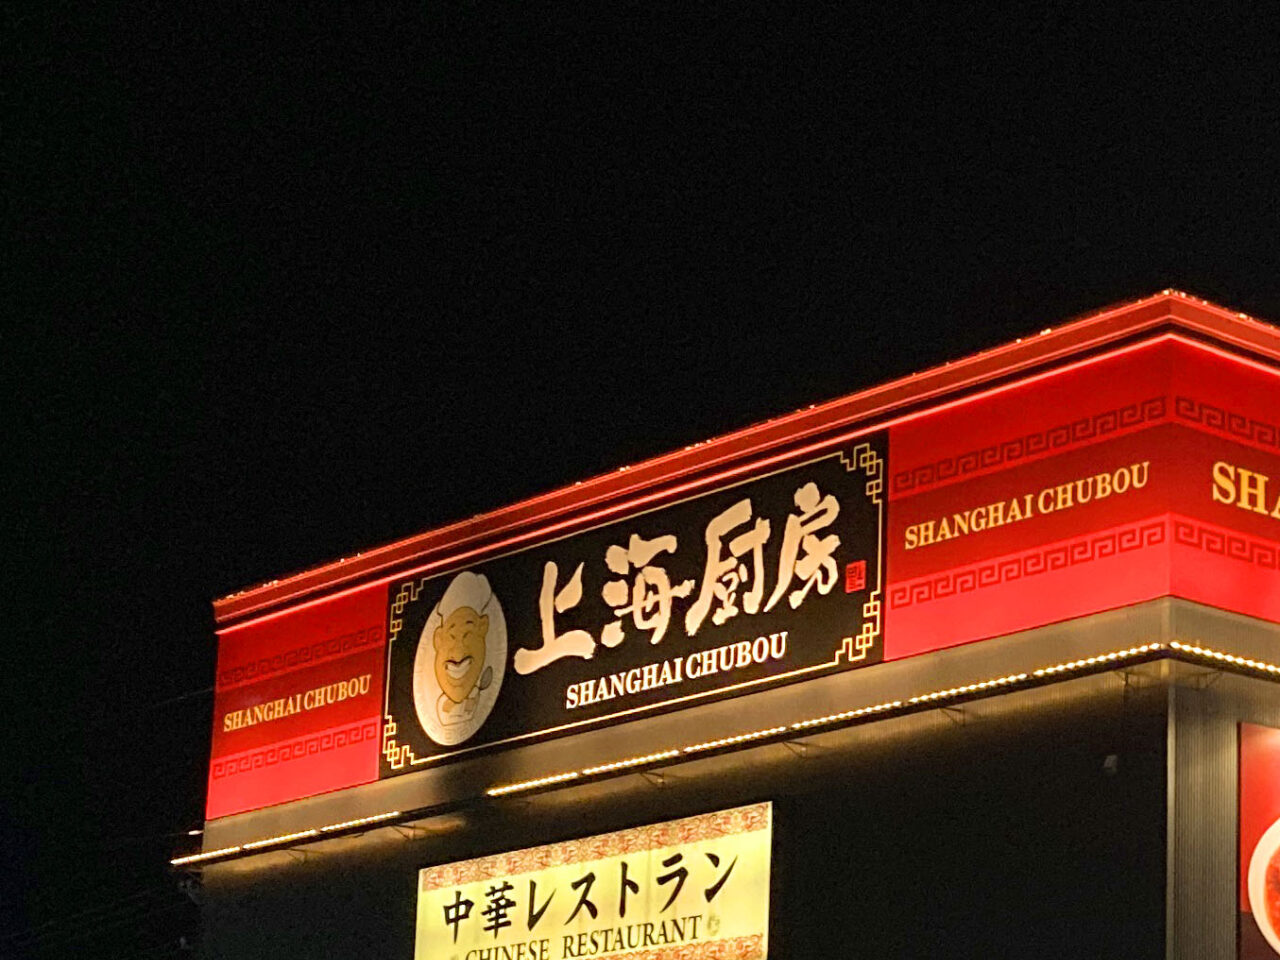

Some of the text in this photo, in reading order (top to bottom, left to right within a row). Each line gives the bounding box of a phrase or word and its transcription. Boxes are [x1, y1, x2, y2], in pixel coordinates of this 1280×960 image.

[904, 461, 1151, 550] SHANGHAI CHUBOU
[514, 481, 840, 676] 上海厨房
[223, 674, 371, 732] SHANGHAI CHUBOU
[566, 631, 788, 709] SHANGHAI CHUBOU
[443, 851, 738, 943] 中華レストラン
[562, 914, 703, 960] RESTAURANT
